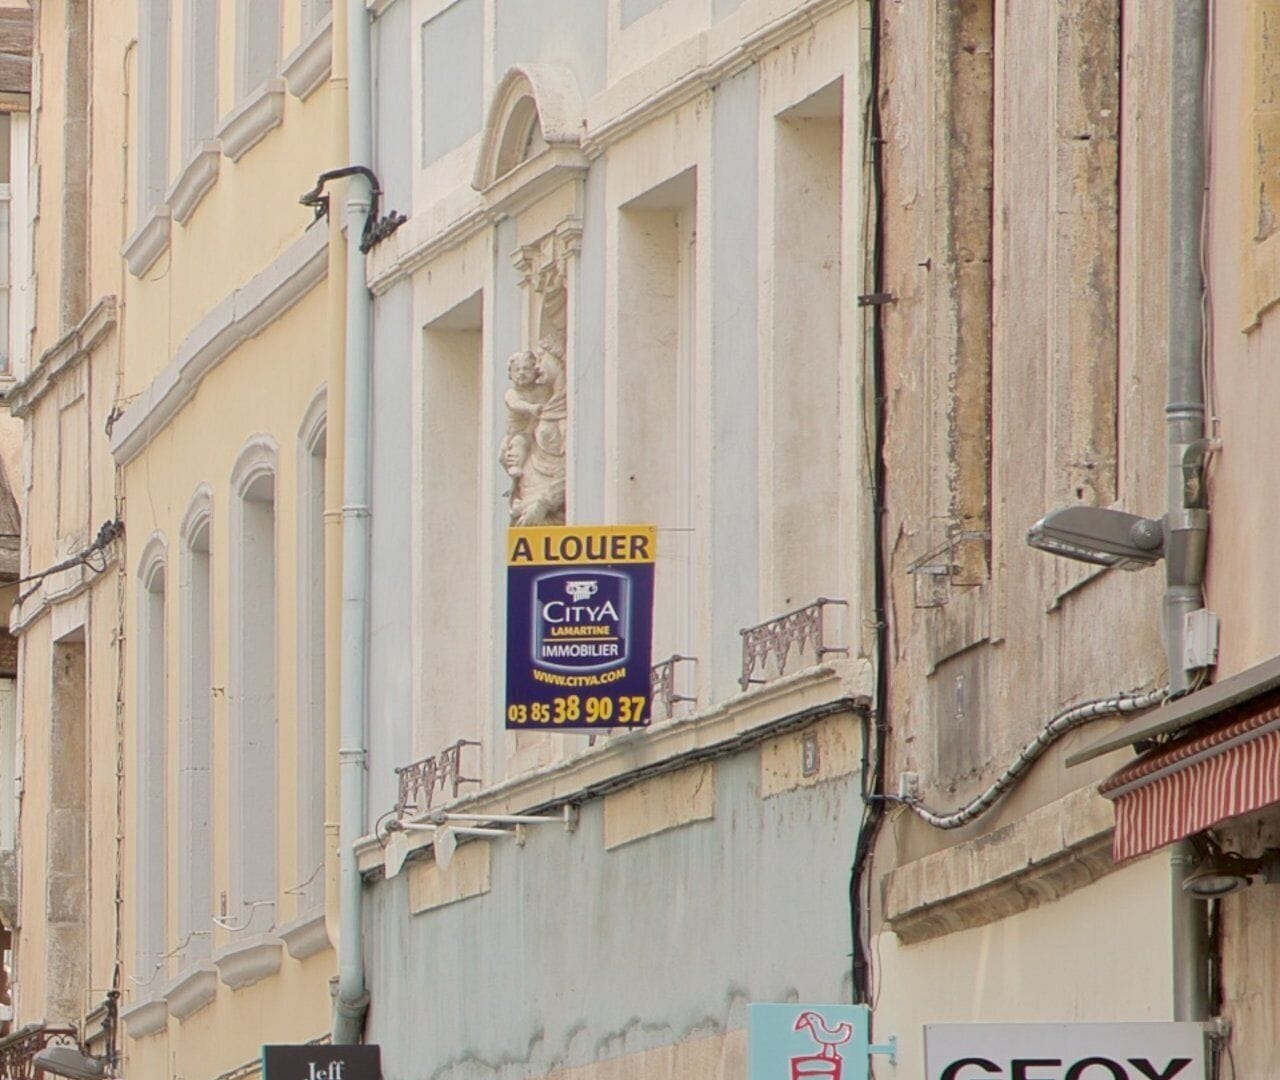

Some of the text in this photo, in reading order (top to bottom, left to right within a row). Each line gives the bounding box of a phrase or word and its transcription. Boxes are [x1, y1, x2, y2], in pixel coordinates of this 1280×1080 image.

[511, 535, 649, 562] A LOUER
[551, 625, 610, 637] LAMARTINE
[542, 643, 619, 658] IMMOBILIER
[533, 668, 626, 687] WWW.CITYA.COM
[508, 695, 646, 723] 03 85 38 90 37
